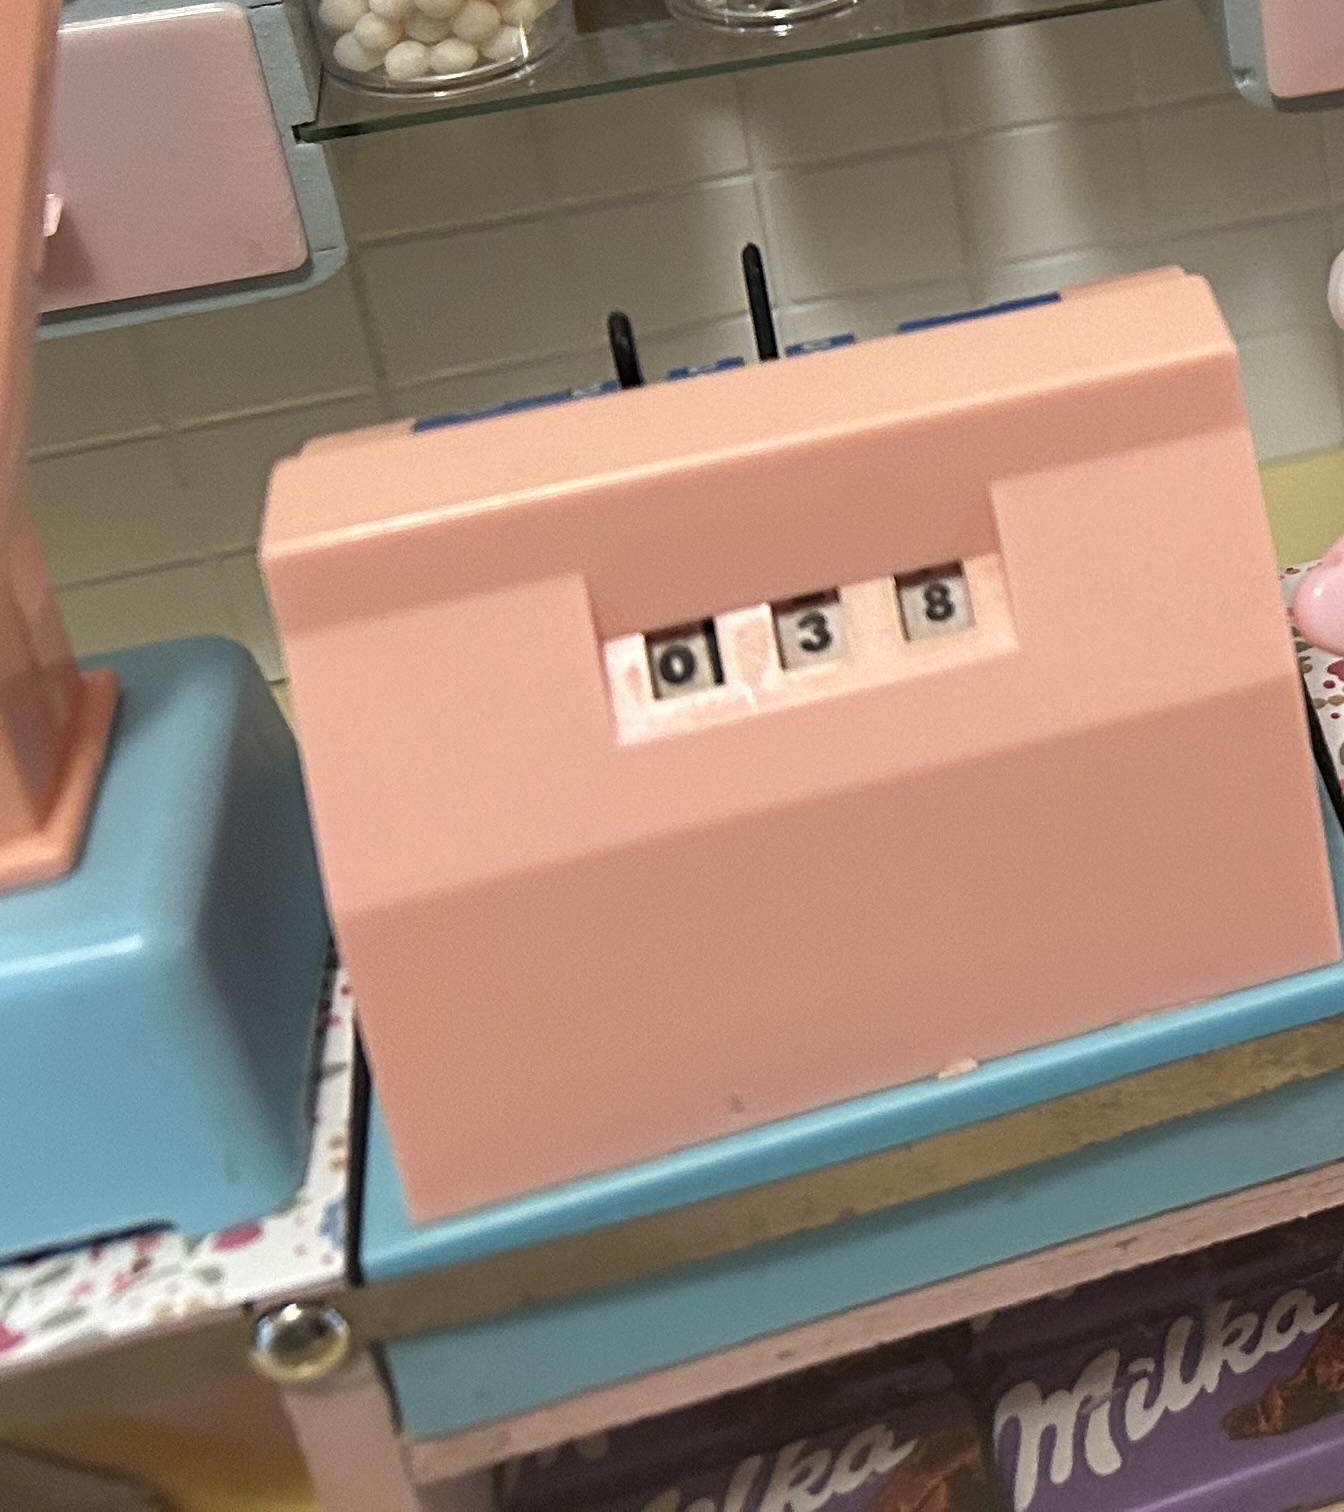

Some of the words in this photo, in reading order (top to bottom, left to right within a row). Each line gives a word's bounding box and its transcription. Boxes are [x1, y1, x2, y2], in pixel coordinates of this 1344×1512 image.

[659, 644, 696, 684] 0
[796, 609, 833, 653] 3
[923, 581, 956, 622] 8
[993, 1288, 1340, 1512] Milka
[641, 1424, 919, 1512] lka
